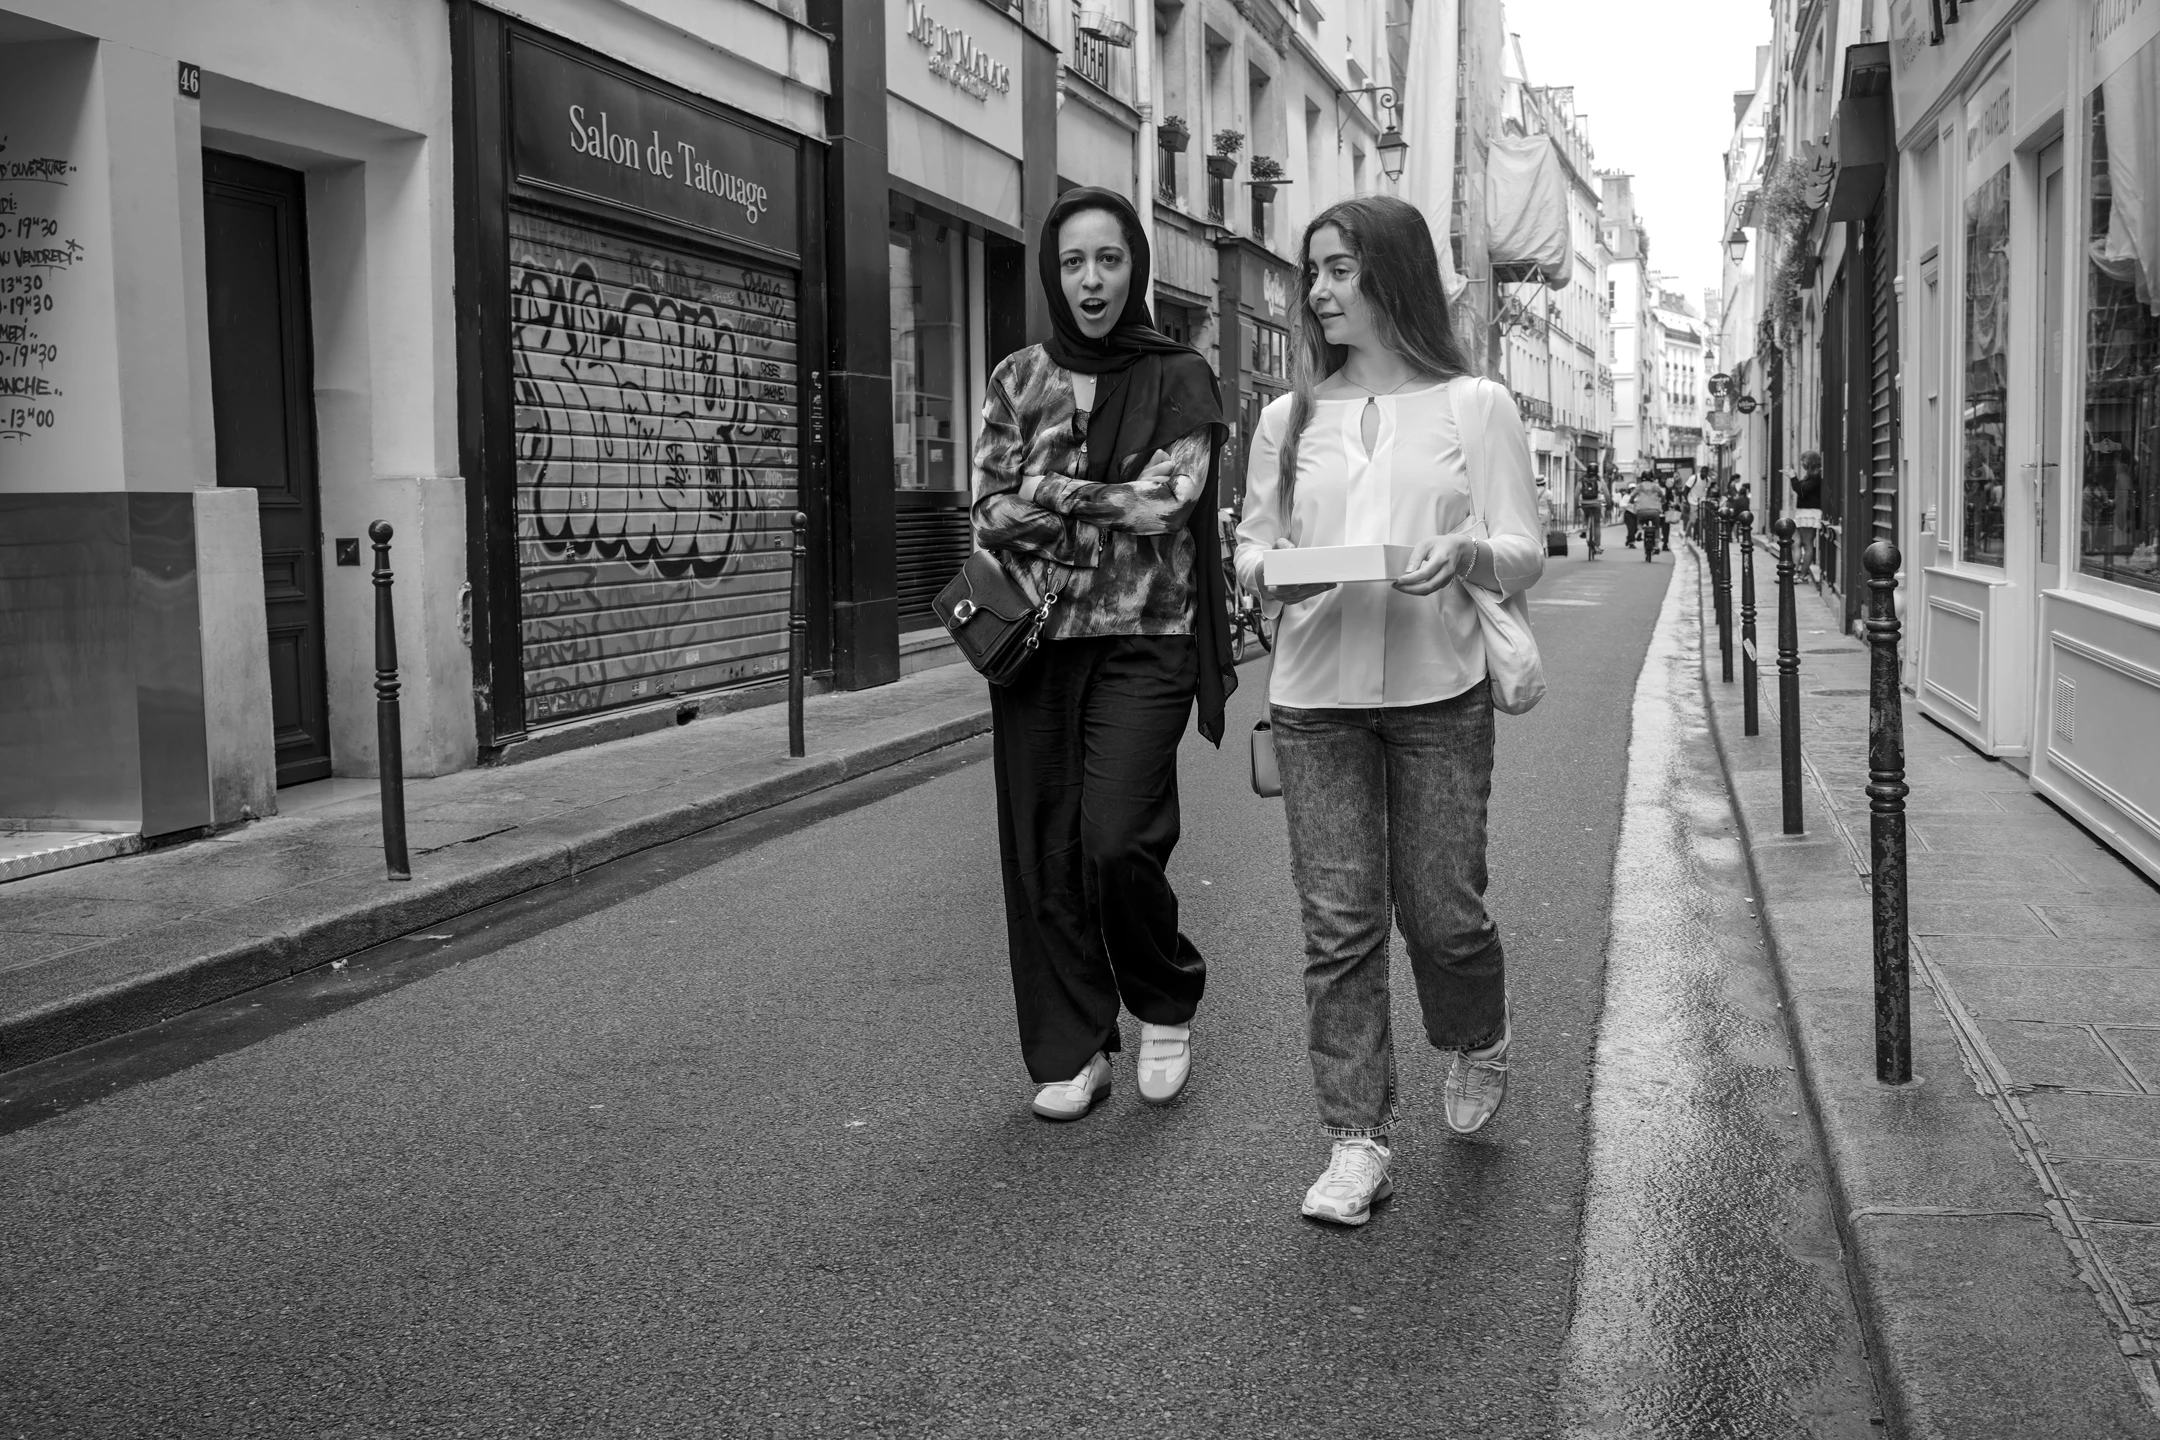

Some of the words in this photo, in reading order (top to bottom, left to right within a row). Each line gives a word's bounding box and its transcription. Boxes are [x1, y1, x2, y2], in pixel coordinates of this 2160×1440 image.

[180, 67, 199, 93] 46
[954, 28, 1010, 94] MARAIS
[569, 104, 640, 171] Salon
[646, 130, 674, 180] de
[677, 140, 768, 225] Tatouage
